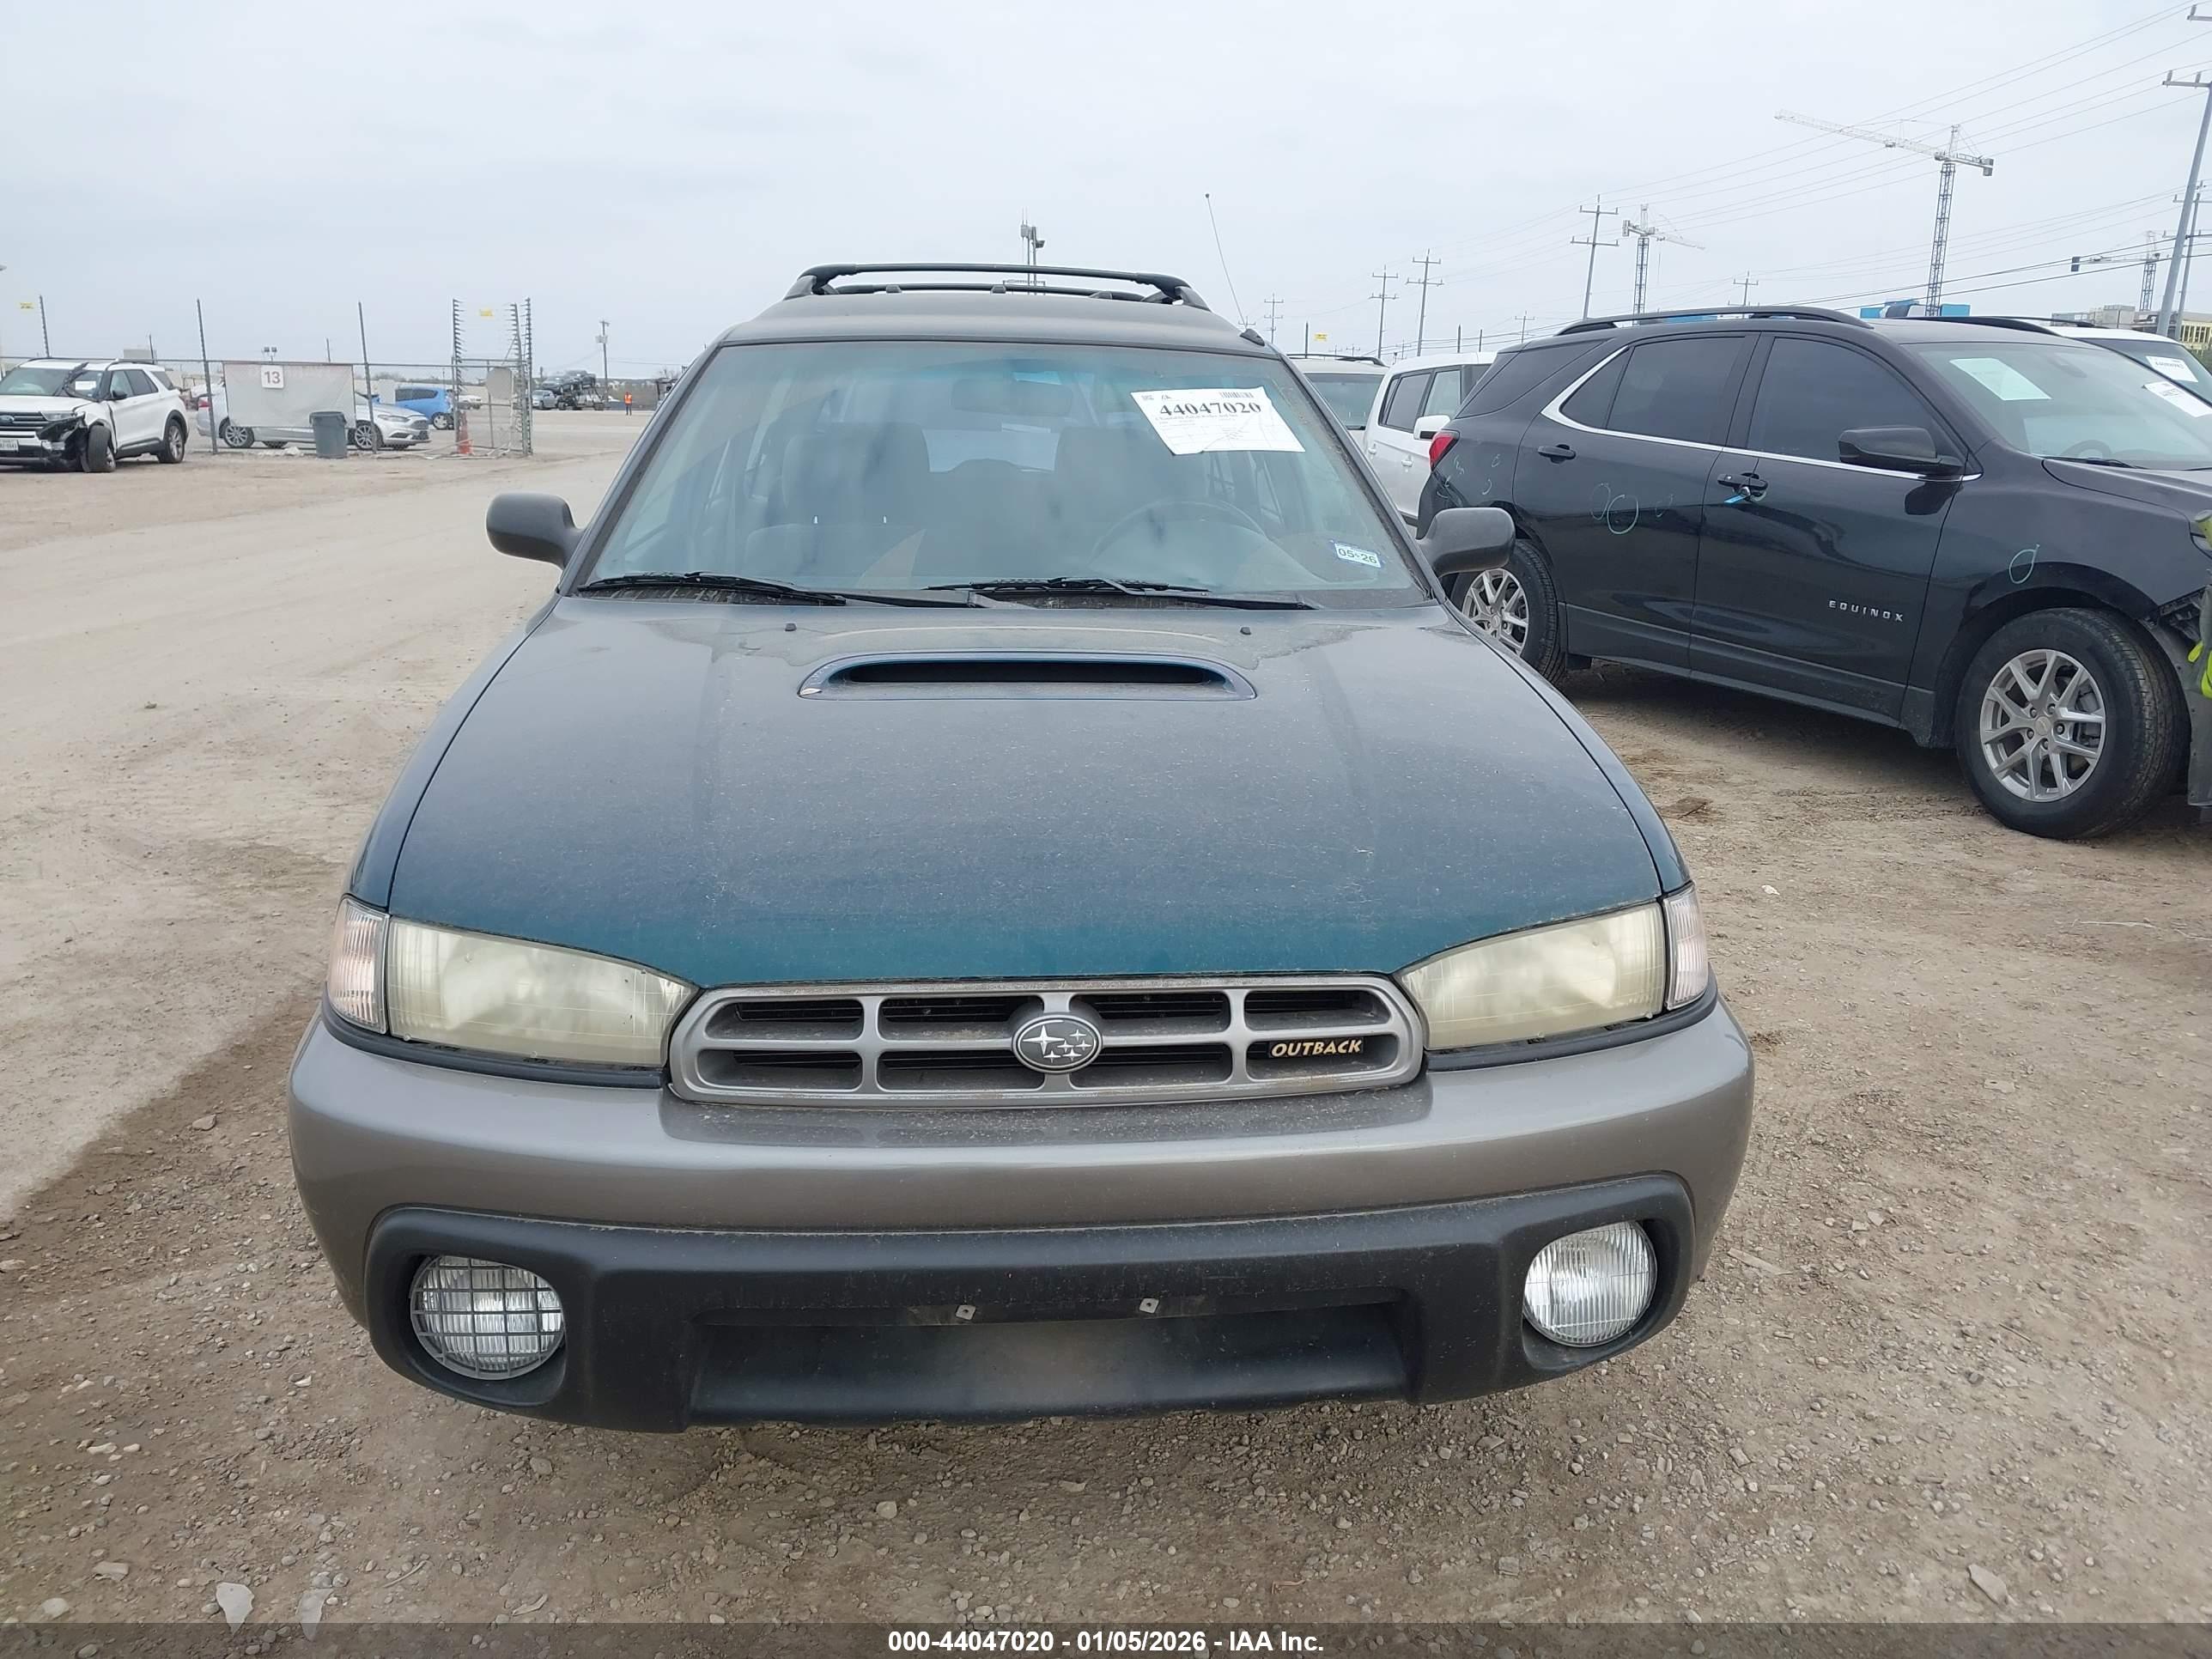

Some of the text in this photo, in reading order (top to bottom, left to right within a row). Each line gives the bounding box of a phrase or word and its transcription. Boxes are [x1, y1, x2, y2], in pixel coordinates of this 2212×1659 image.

[264, 371, 281, 384] 13
[1160, 401, 1261, 416] 44047020
[1828, 600, 1904, 622] EQUINOX
[1271, 1039, 1362, 1057] OUTBACK
